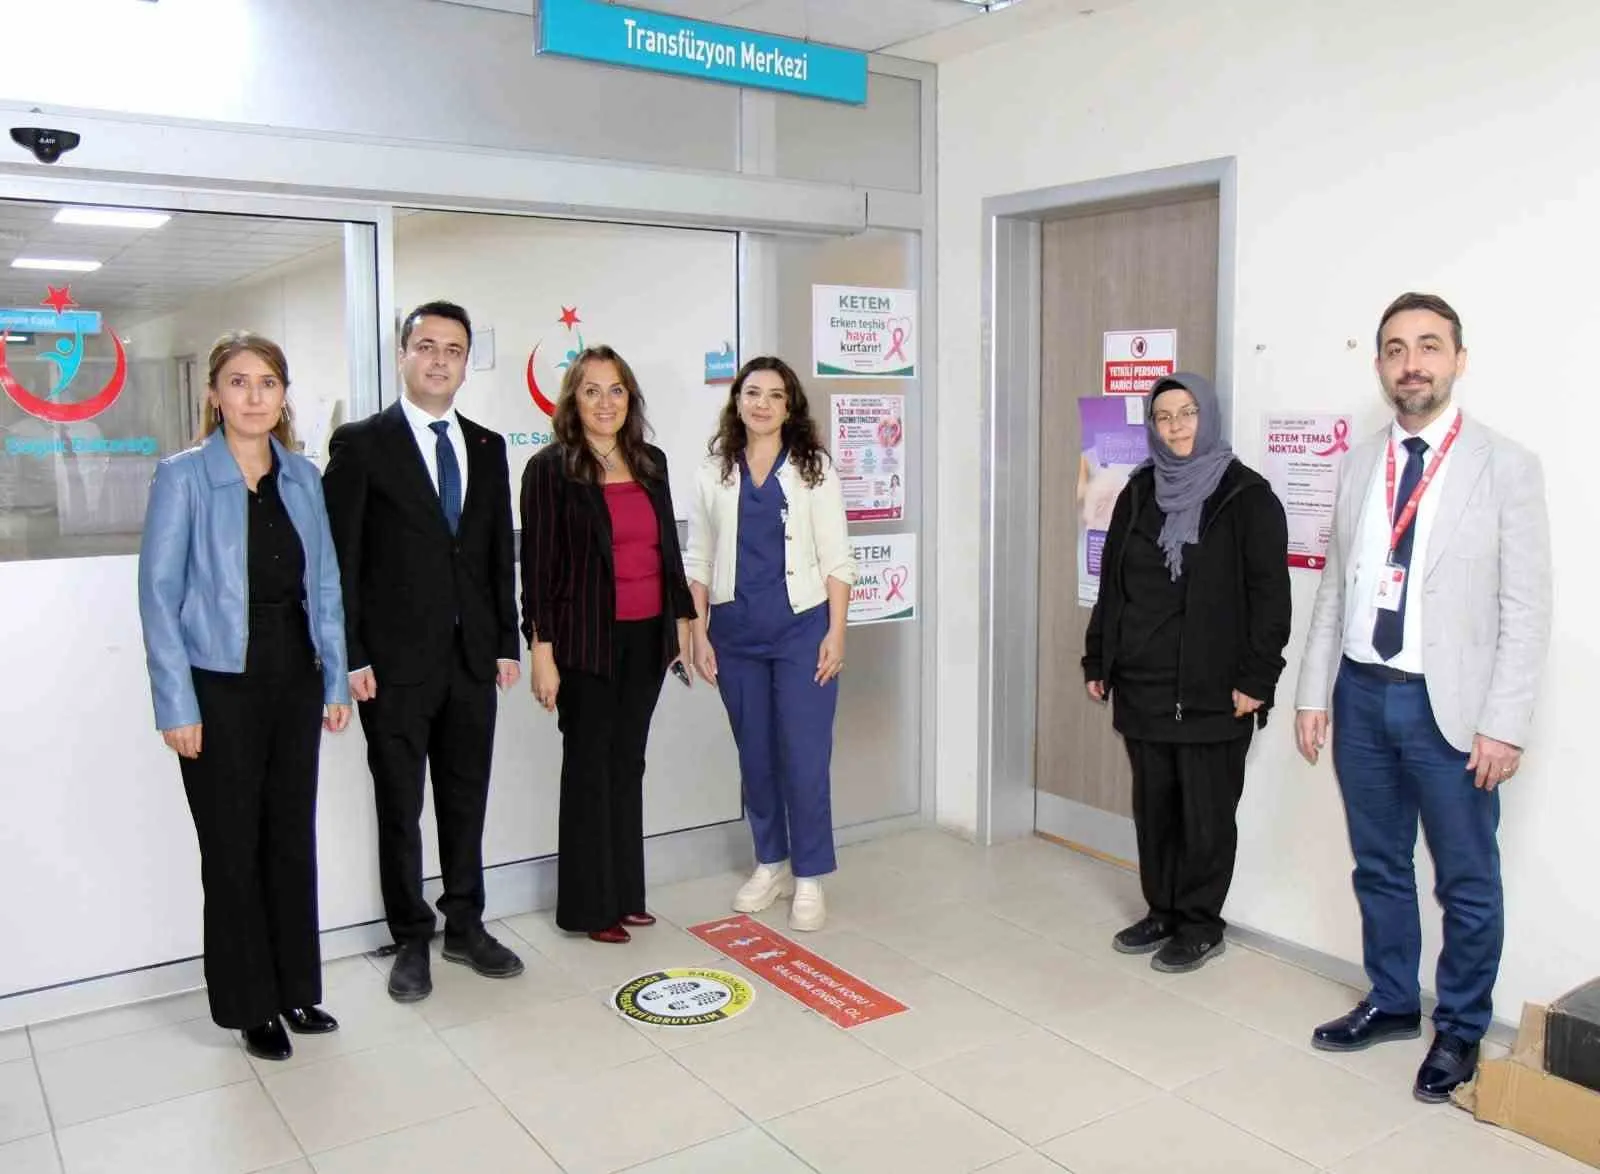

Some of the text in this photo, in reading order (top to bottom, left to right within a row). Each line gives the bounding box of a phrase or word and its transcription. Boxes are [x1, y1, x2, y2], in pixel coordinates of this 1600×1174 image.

[624, 18, 808, 81] Transfüzyon Merkezi
[839, 295, 890, 310] KETEM
[830, 317, 857, 328] Erken
[846, 330, 877, 343] hayat
[1268, 433, 1332, 443] KETEM TEMAS
[1268, 444, 1306, 454] NOKTASI
[853, 545, 891, 559] ETEM
